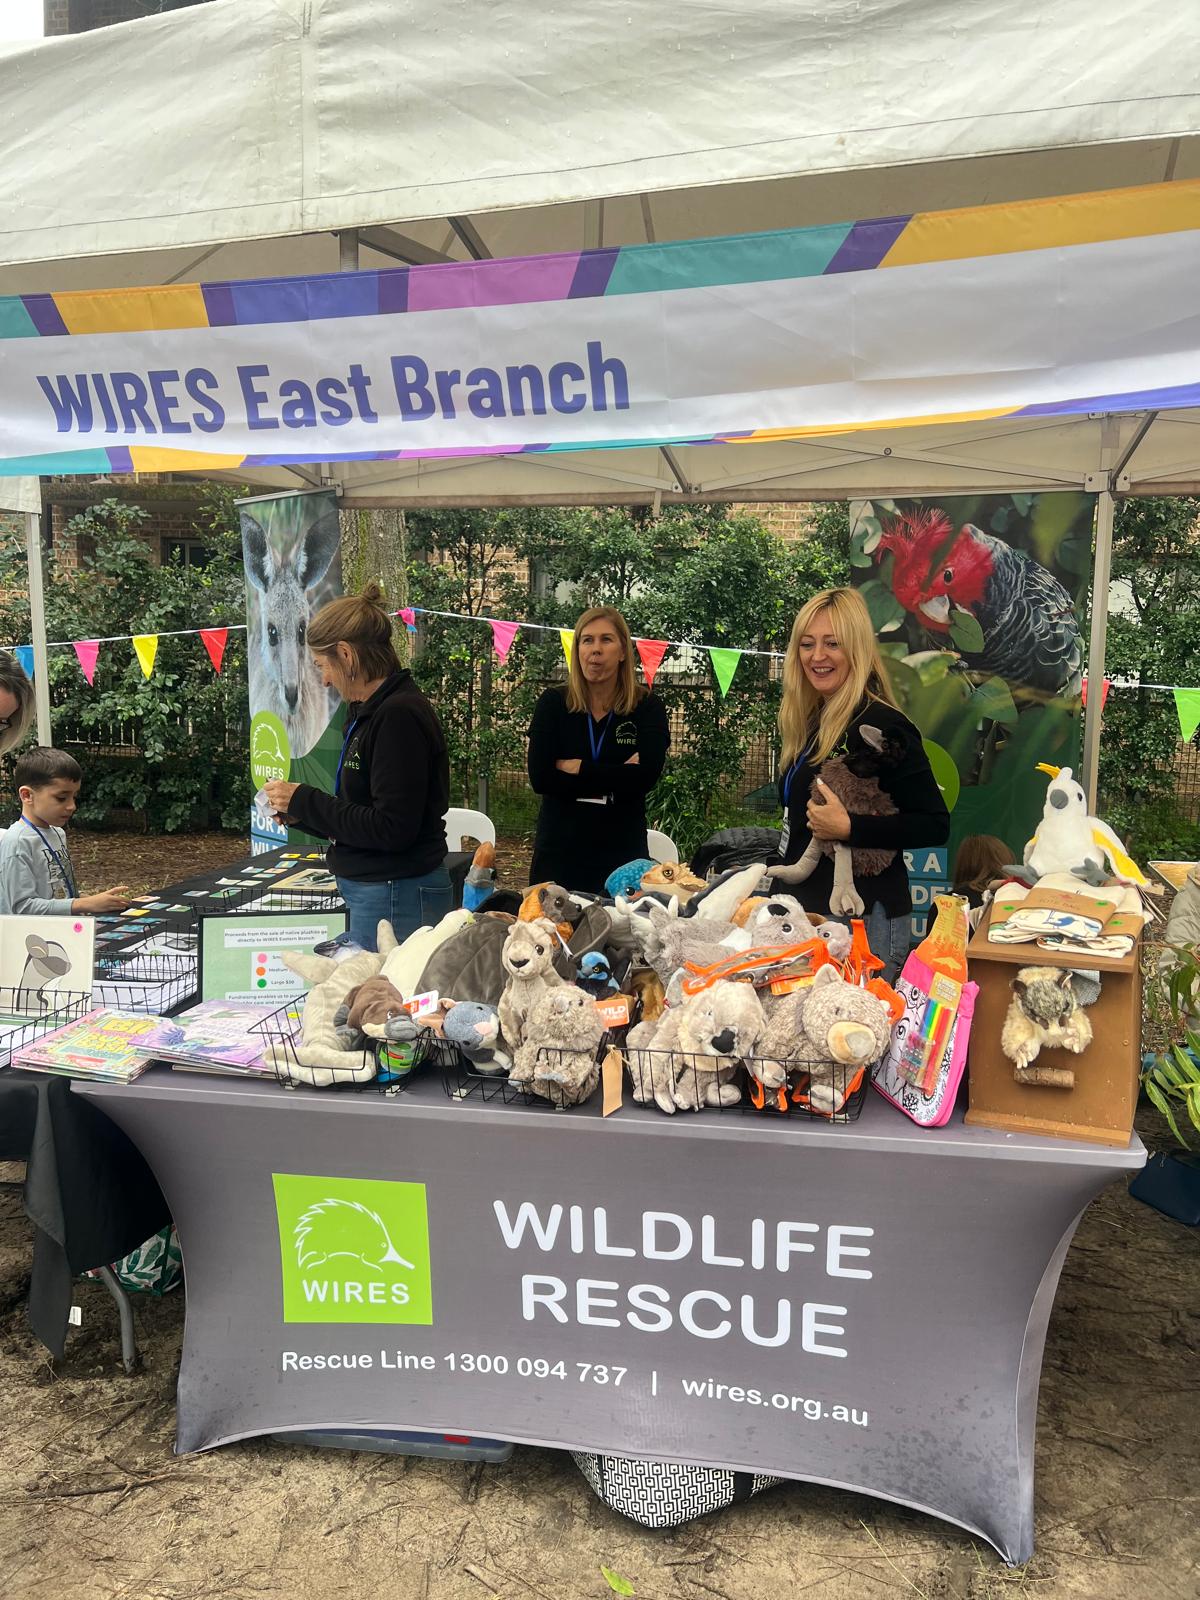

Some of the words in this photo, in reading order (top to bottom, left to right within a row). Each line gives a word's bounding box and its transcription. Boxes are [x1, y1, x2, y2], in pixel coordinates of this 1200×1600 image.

[36, 367, 225, 435] WIRES
[238, 364, 379, 431] East
[391, 341, 630, 421] Branch
[254, 764, 285, 781] WIRES
[492, 1199, 875, 1281] WILDLIFE
[302, 1279, 411, 1306] WIRES
[521, 1273, 849, 1360] RESCUE
[281, 1350, 374, 1373] Rescue
[380, 1348, 436, 1371] Line
[443, 1351, 509, 1376] 1300
[516, 1356, 568, 1382] 094
[575, 1361, 628, 1388] 737
[681, 1376, 869, 1428] wires.org.au
